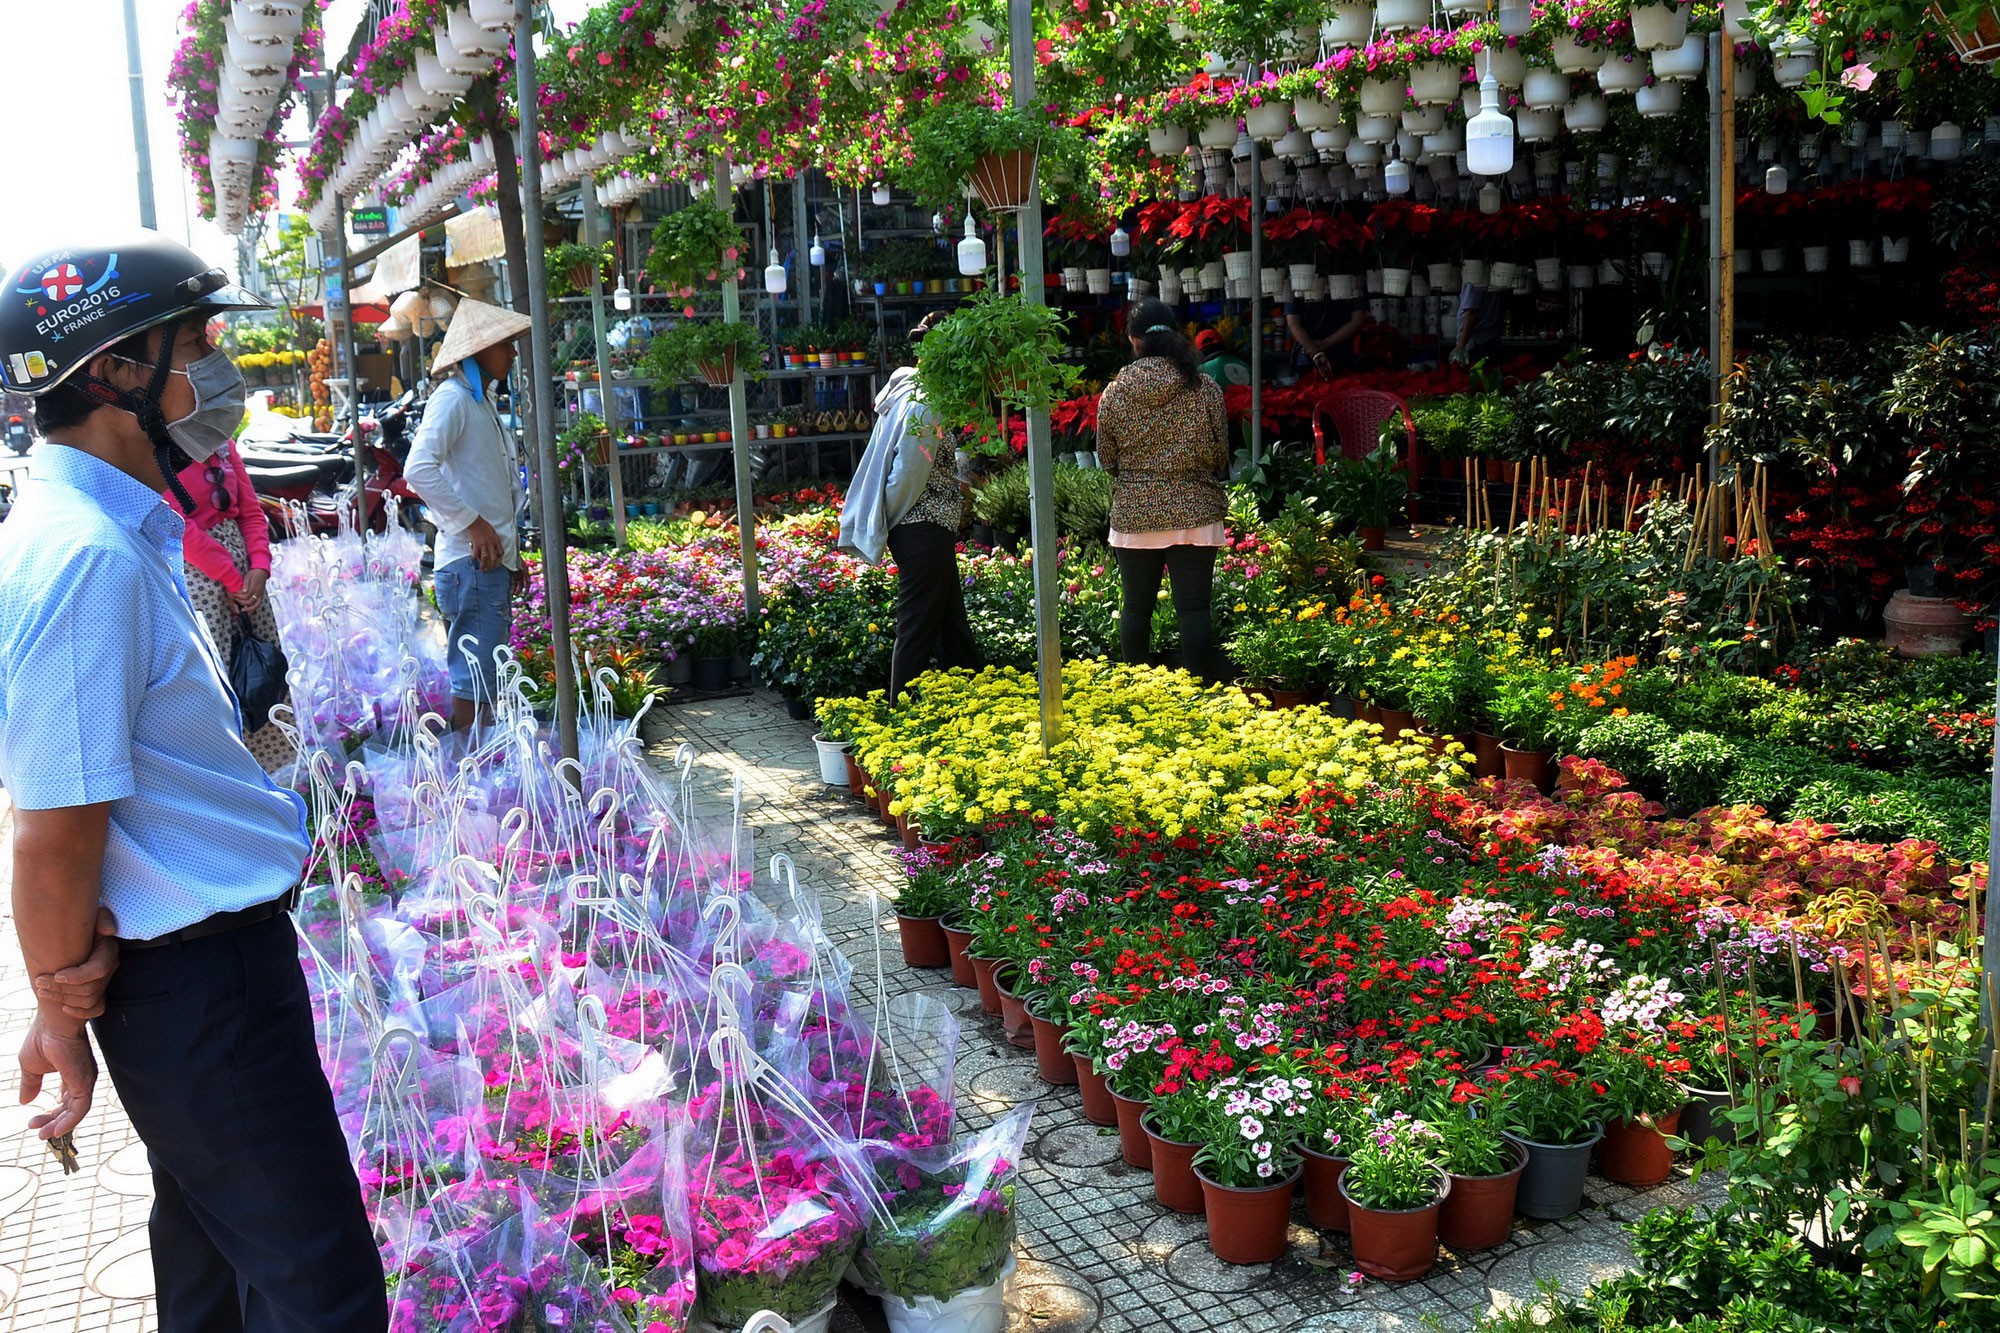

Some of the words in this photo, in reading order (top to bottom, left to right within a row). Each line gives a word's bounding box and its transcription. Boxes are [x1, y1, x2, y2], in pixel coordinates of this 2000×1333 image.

[354, 222, 368, 230] GIA
[32, 250, 70, 275] UEFA
[63, 308, 106, 334] FRANCE
